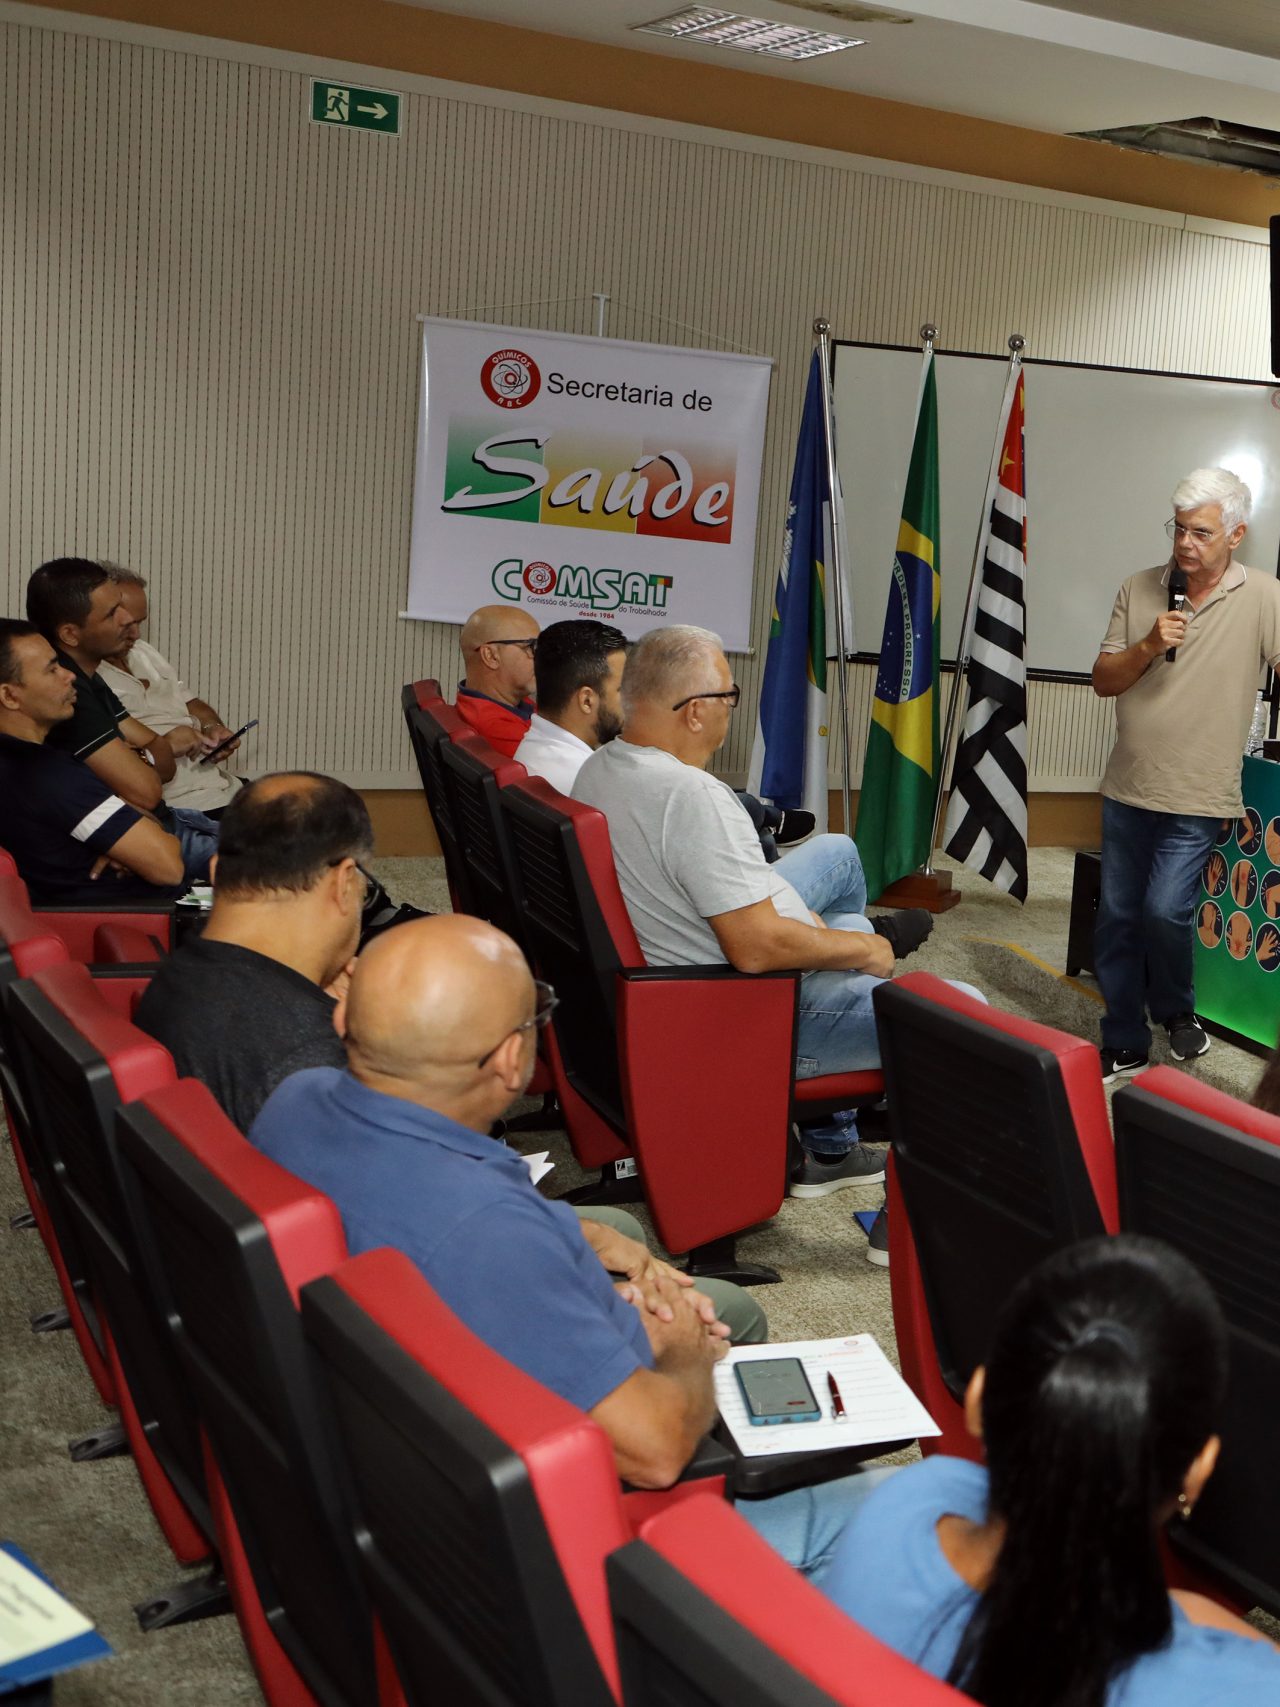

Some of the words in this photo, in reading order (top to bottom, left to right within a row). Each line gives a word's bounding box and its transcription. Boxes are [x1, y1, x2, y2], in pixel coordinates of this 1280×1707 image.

[547, 373, 674, 408] Secretaria
[682, 389, 713, 412] de
[440, 427, 730, 526] Saúde
[491, 558, 674, 612] COMSAT
[527, 595, 558, 607] Comissão
[559, 599, 568, 608] de
[569, 599, 590, 610] Saúde
[618, 606, 628, 614] do
[579, 610, 597, 618] desde
[600, 612, 615, 620] 1984
[902, 613, 913, 697] PROGRESSO
